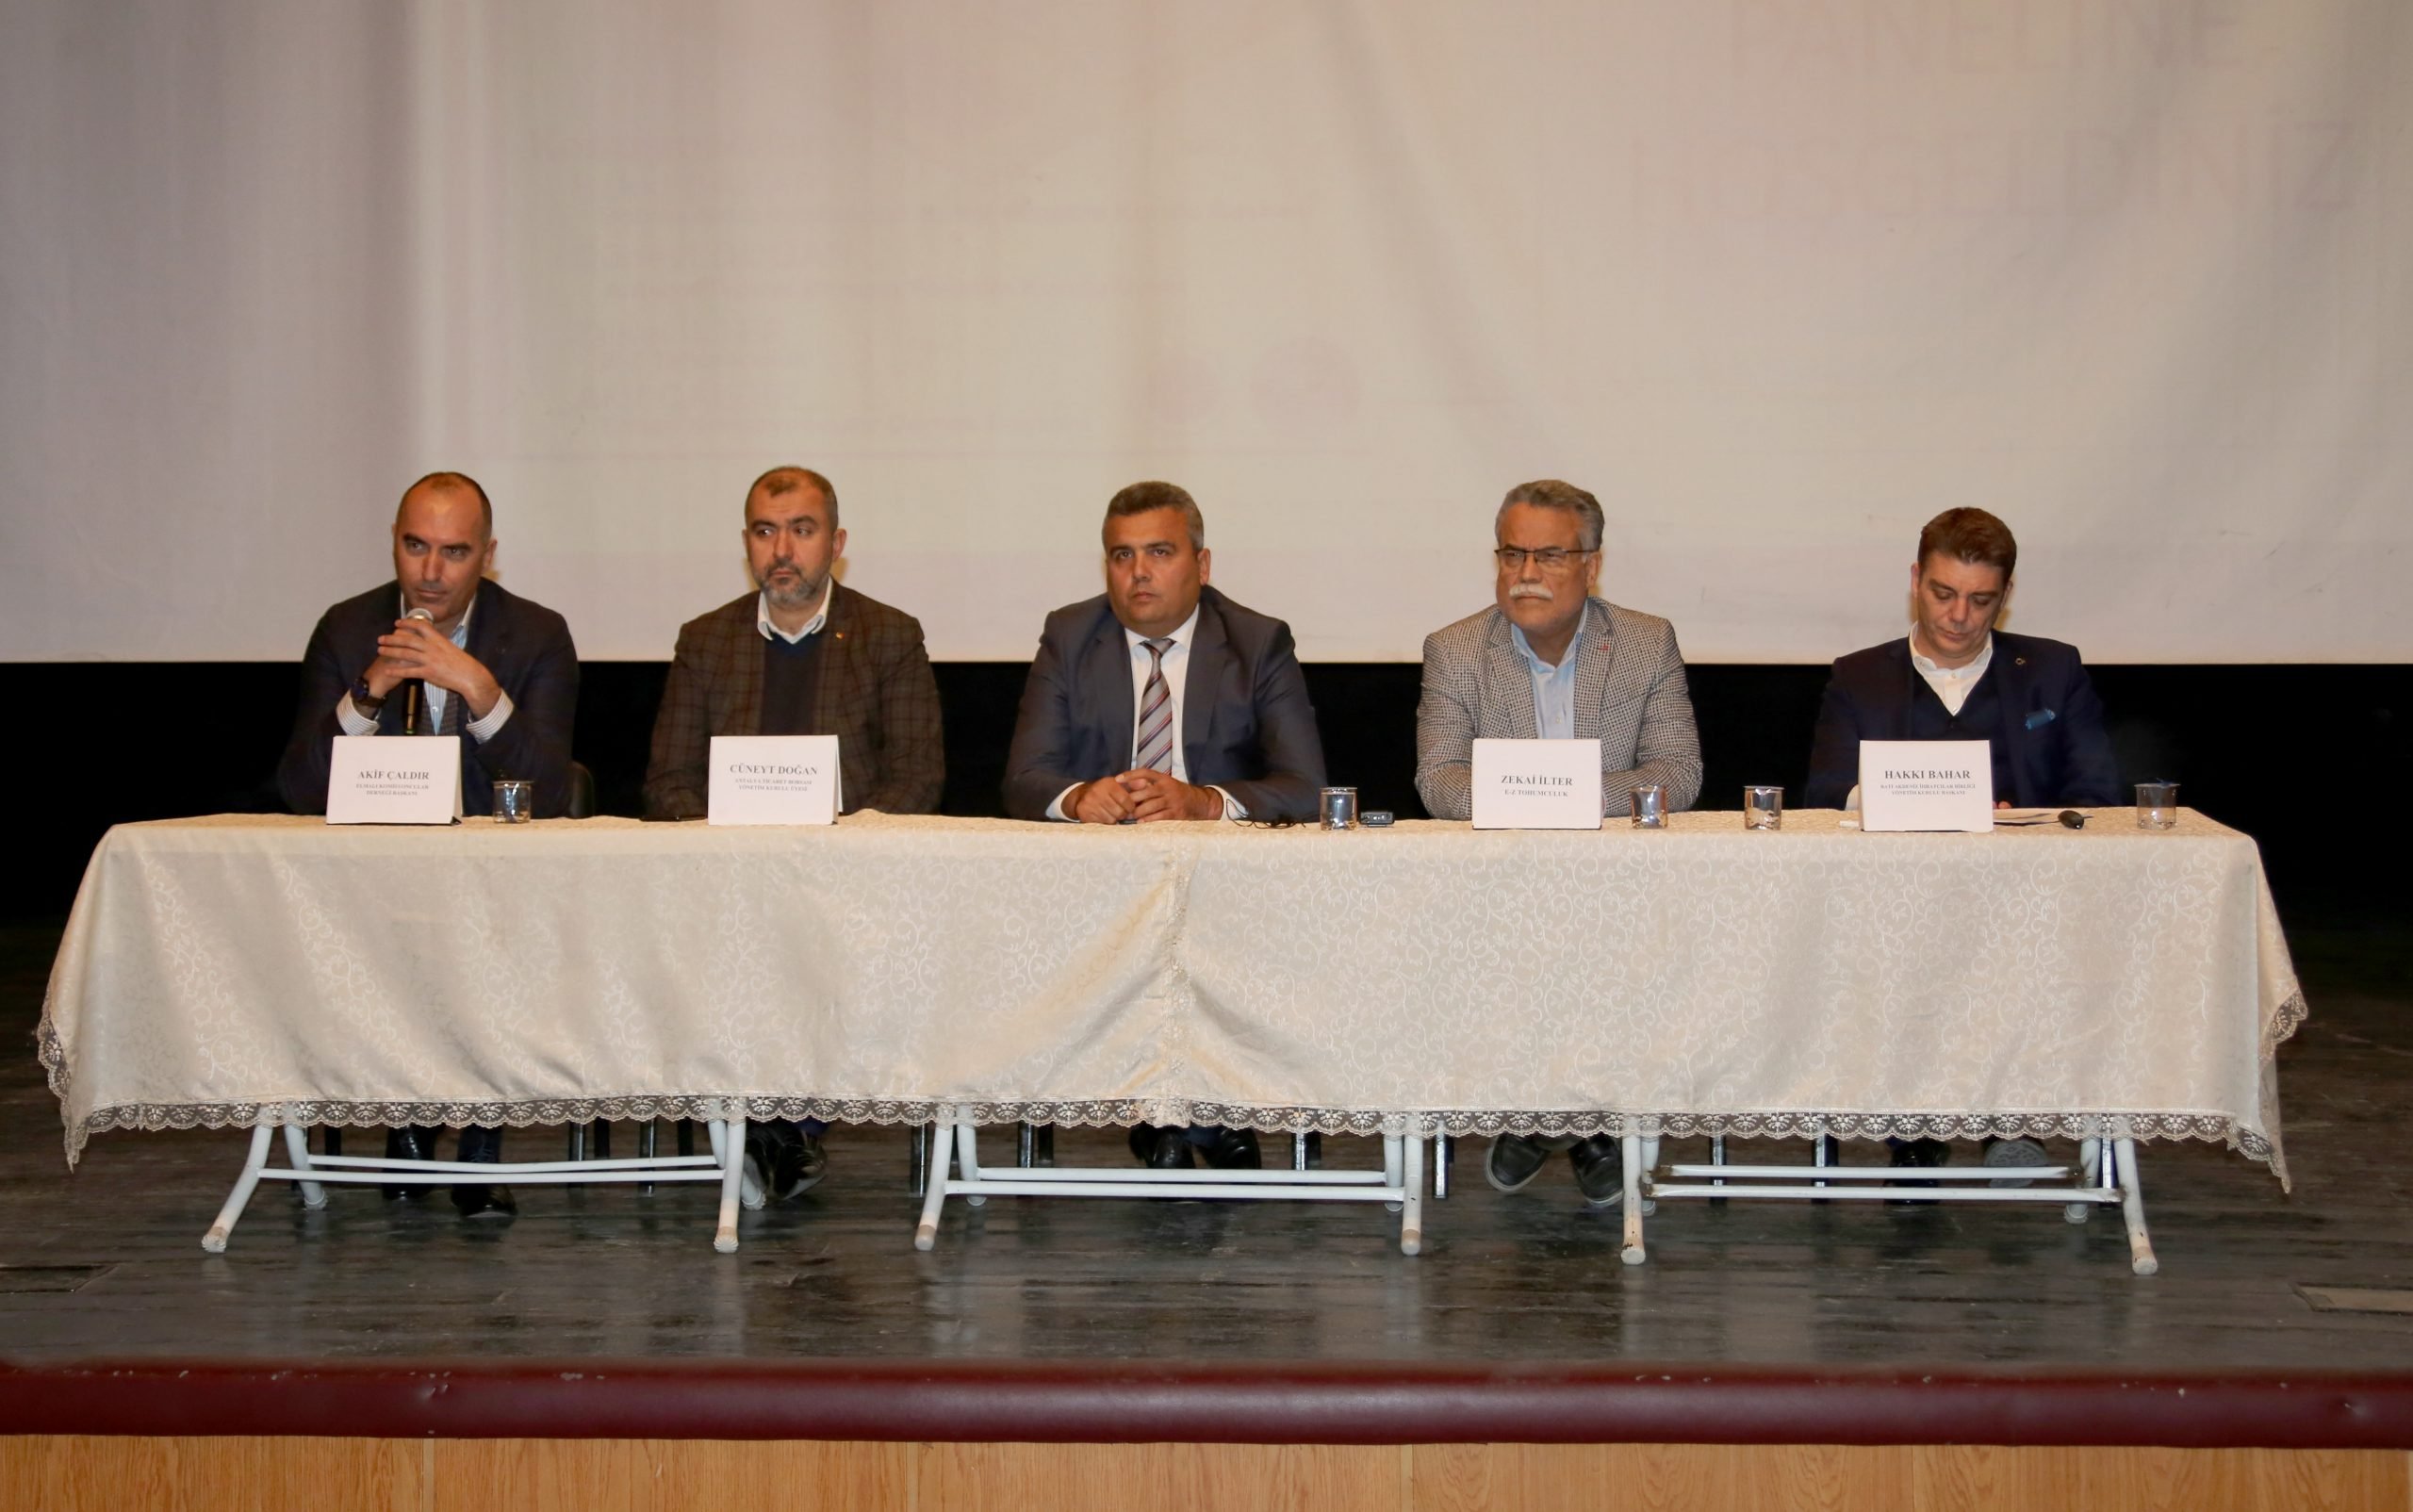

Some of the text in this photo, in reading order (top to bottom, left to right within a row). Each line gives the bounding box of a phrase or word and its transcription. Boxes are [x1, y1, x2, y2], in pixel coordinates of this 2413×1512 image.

[357, 769, 430, 781] AKİF ÇALDIR
[729, 763, 818, 776] CÜNEYT DOĞAN
[1885, 769, 1971, 780] HAKKI BAHAR
[1501, 774, 1573, 786] ZEKAİ İLTER
